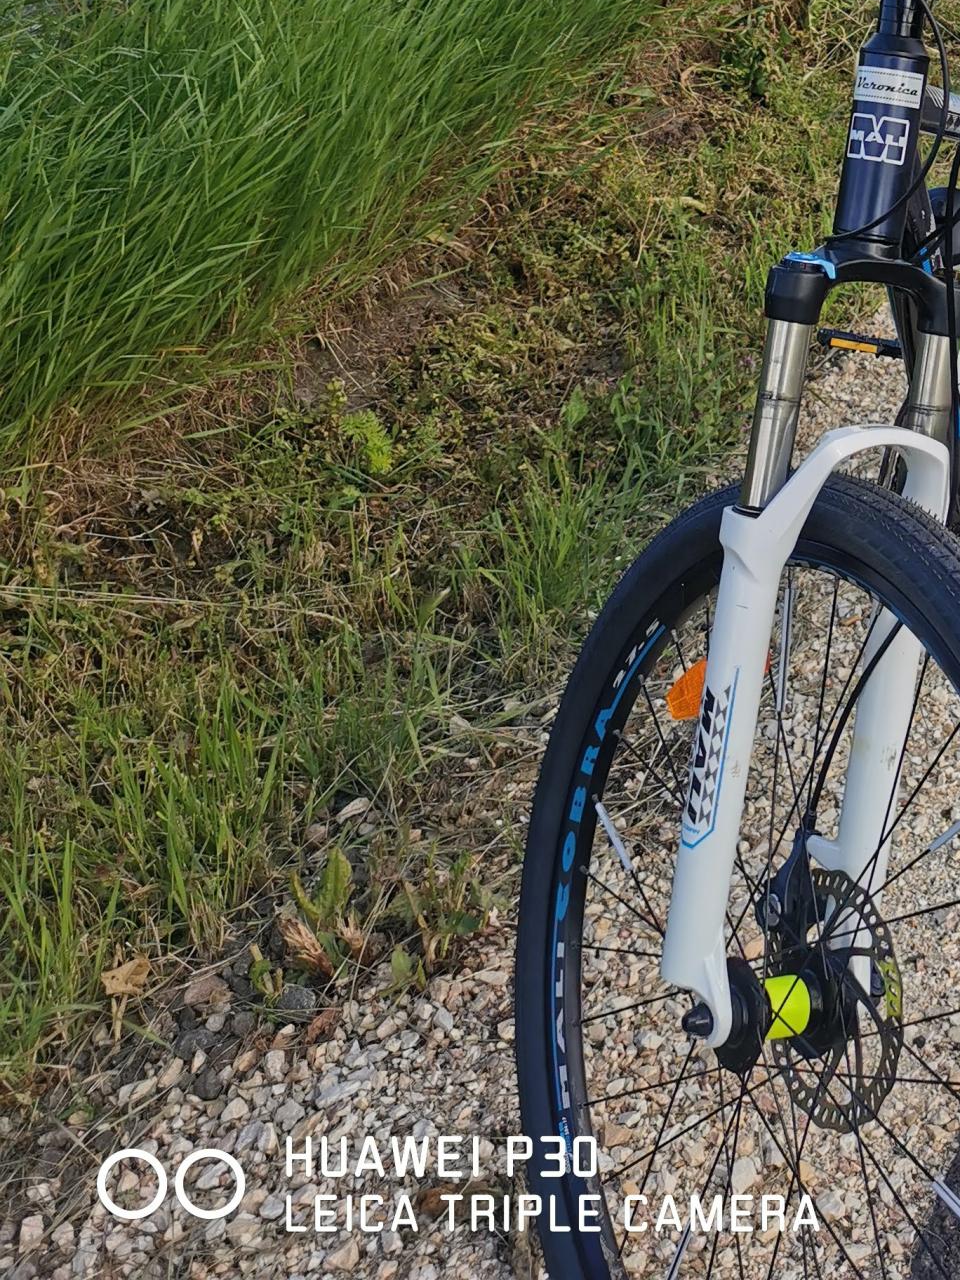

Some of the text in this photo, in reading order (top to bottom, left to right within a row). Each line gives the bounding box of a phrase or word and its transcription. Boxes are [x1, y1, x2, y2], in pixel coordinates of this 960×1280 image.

[857, 76, 918, 97] Veronica
[612, 618, 660, 689] 27.5
[556, 707, 614, 920] COBRA
